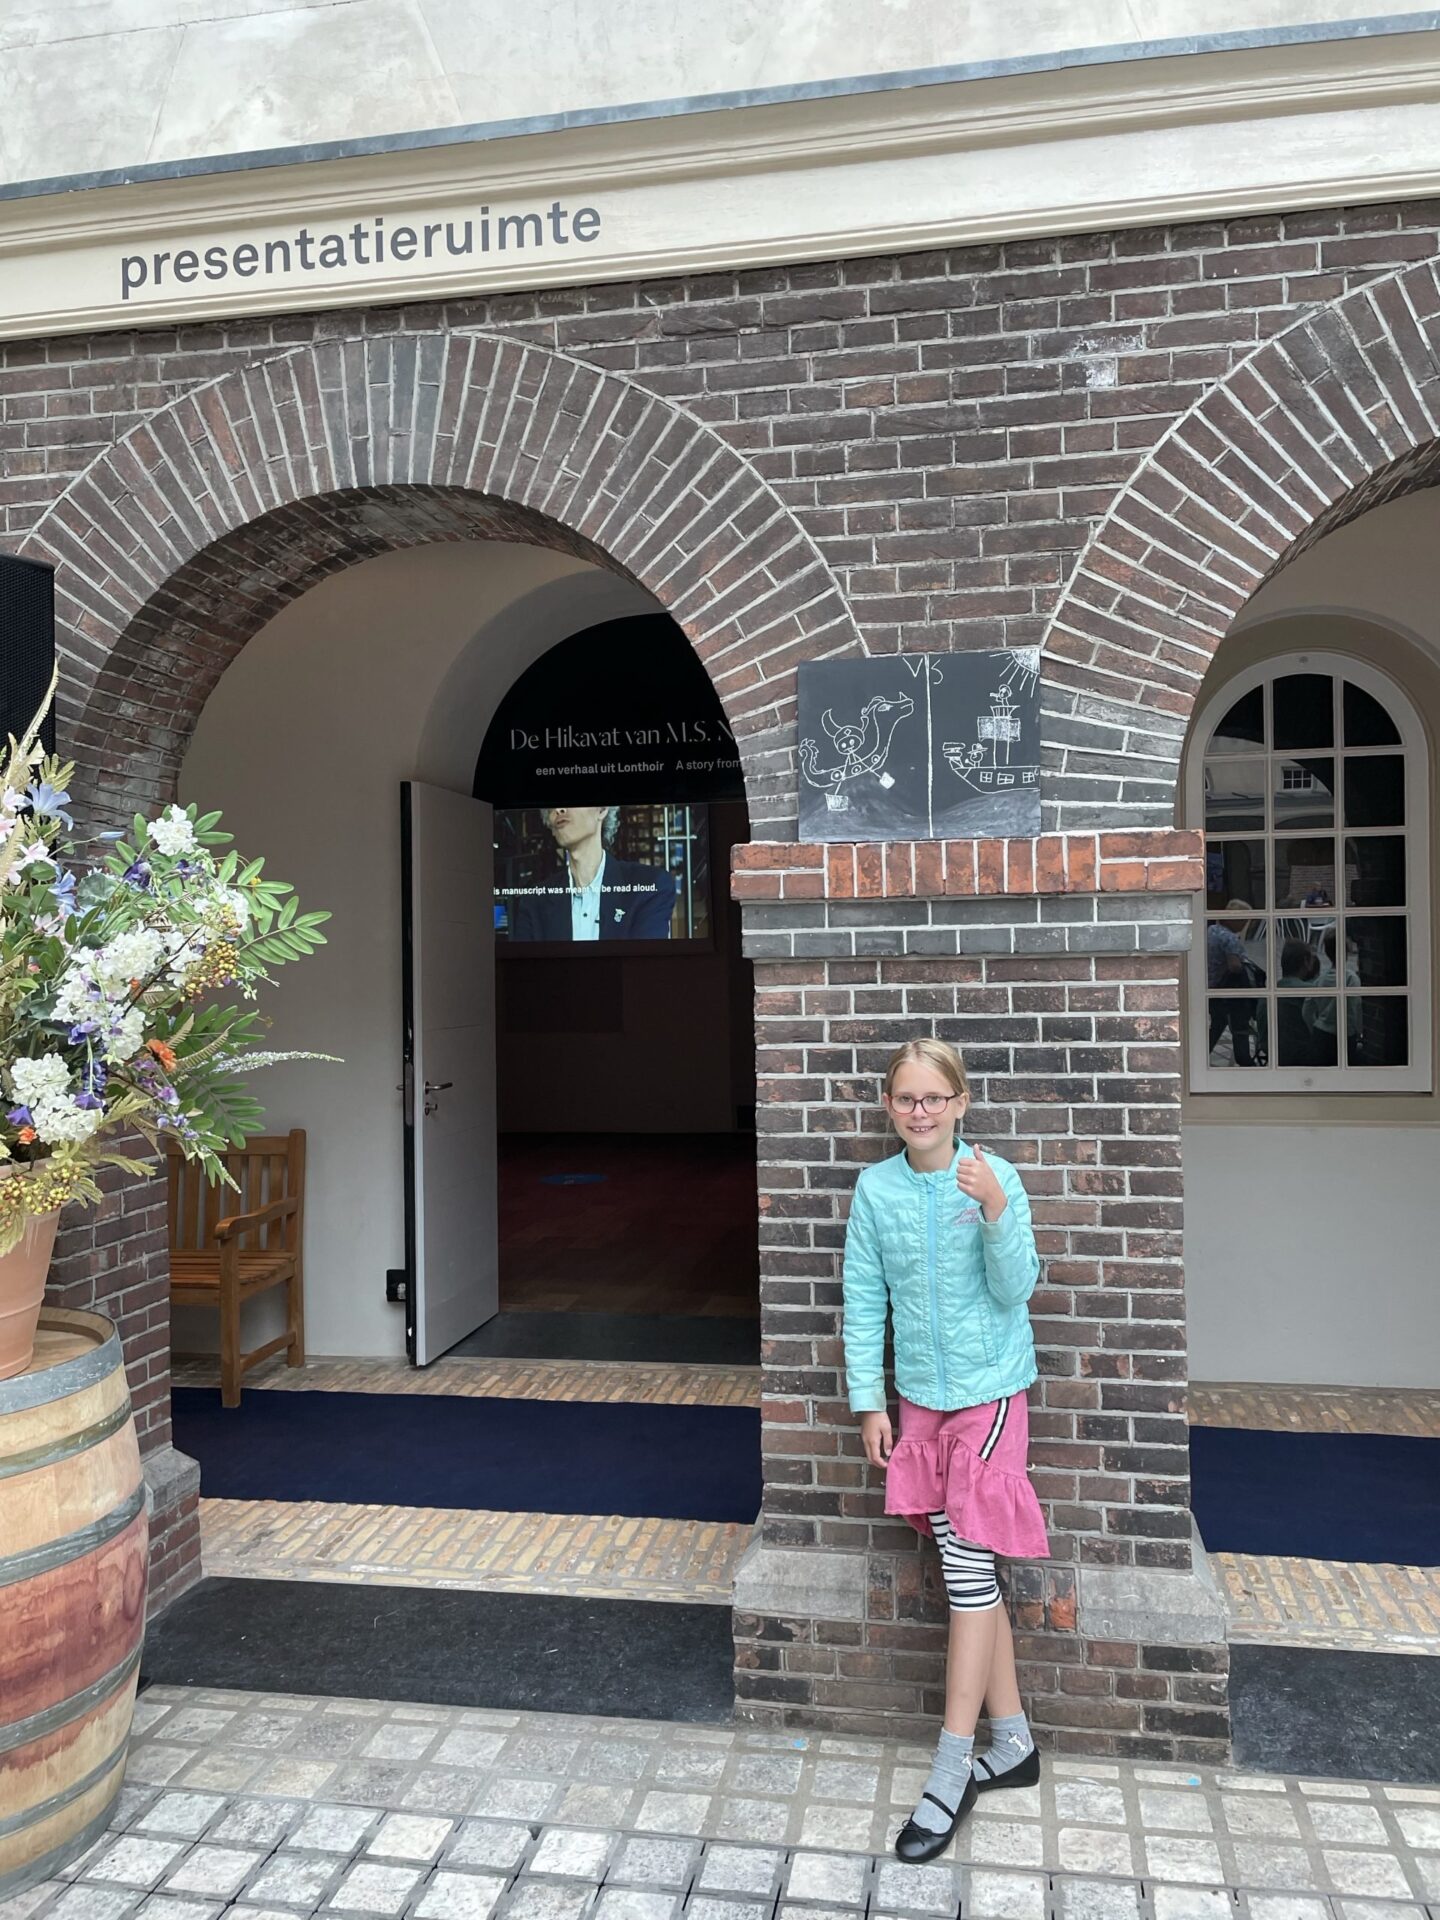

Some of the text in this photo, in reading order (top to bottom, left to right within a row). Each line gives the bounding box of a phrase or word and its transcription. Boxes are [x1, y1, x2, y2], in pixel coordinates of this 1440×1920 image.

[120, 201, 602, 300] presentatieruimte
[510, 728, 540, 751] De
[625, 728, 661, 746] van
[535, 766, 556, 776] een
[557, 763, 598, 775] verhaal
[600, 762, 616, 774] uit
[617, 760, 665, 773] Lonthoir
[675, 760, 684, 771] A
[686, 759, 715, 773] story
[501, 885, 546, 897] manuscript
[547, 886, 564, 895] was
[601, 884, 612, 894] be
[613, 884, 632, 893] read
